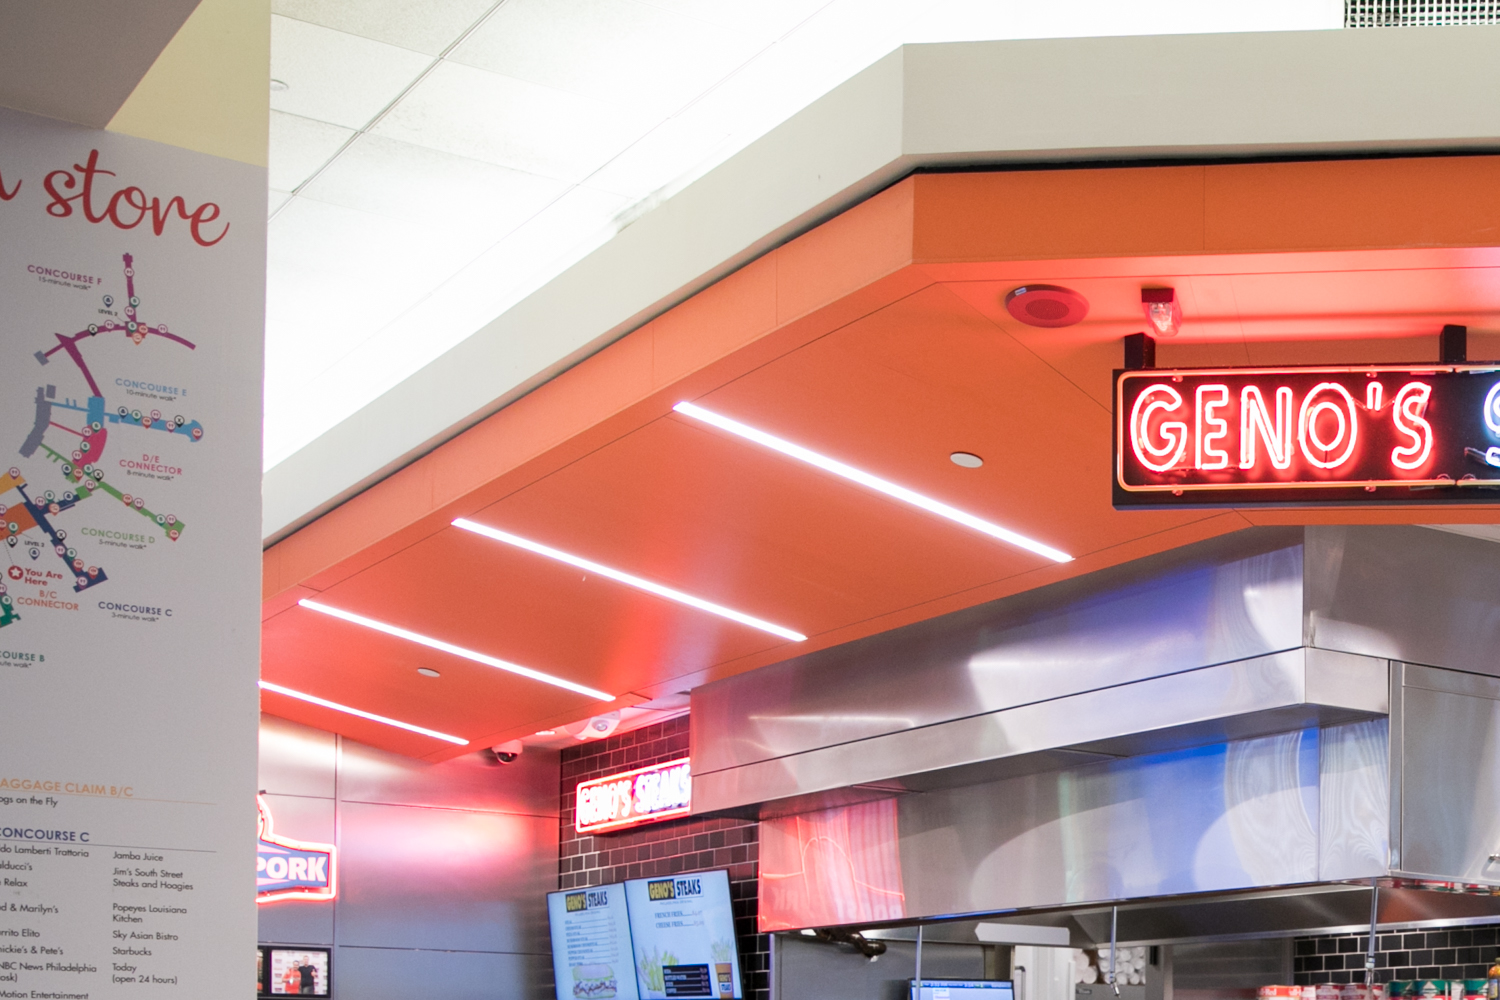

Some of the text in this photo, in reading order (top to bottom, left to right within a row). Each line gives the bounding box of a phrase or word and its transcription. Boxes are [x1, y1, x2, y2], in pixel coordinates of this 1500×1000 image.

[43, 149, 230, 247] store
[27, 264, 94, 284] CONCOURSE
[38, 276, 72, 288] 15-minute
[115, 378, 179, 395] CONCOURSE
[126, 389, 158, 399] 10-minute
[1129, 382, 1432, 471] GENO'S
[142, 454, 160, 464] D/E
[119, 459, 183, 475] CONNECTOR
[81, 527, 155, 544] CONCOURSE D
[25, 568, 63, 580] You Are
[25, 578, 48, 586] Here
[39, 590, 57, 599] B/C
[17, 597, 79, 611] CONNECTOR
[98, 601, 173, 617] CONCOURSE C
[0, 651, 45, 662] OURSE B
[64, 782, 106, 795] CLAIM
[110, 785, 134, 798] B/C
[16, 796, 58, 808] on the Fly
[0, 827, 90, 843] ONCOURSE C
[14, 845, 51, 855] Lamberti
[54, 847, 89, 858] Trattoria
[112, 851, 164, 861] Jamba Juice
[112, 867, 183, 879] Jim's South Street
[4, 878, 28, 887] Relax
[112, 878, 194, 892] Steaks and Hoagies
[649, 879, 701, 899] GENO'S STEAKS
[10, 903, 59, 915] & Marilyn's
[112, 903, 187, 914] Popeyes Louisiana
[112, 914, 143, 923] Kitchen
[0, 928, 40, 938] rrito Elito
[112, 930, 179, 941] Sky Asian Bistro
[0, 944, 64, 955] ickie's & Pete's
[112, 946, 152, 956] Starbucks
[20, 962, 43, 971] News
[46, 962, 97, 974] Philadelphia
[112, 962, 137, 974] Today
[112, 974, 177, 985] (open 24 hours)
[31, 990, 89, 1000] Entertainment
